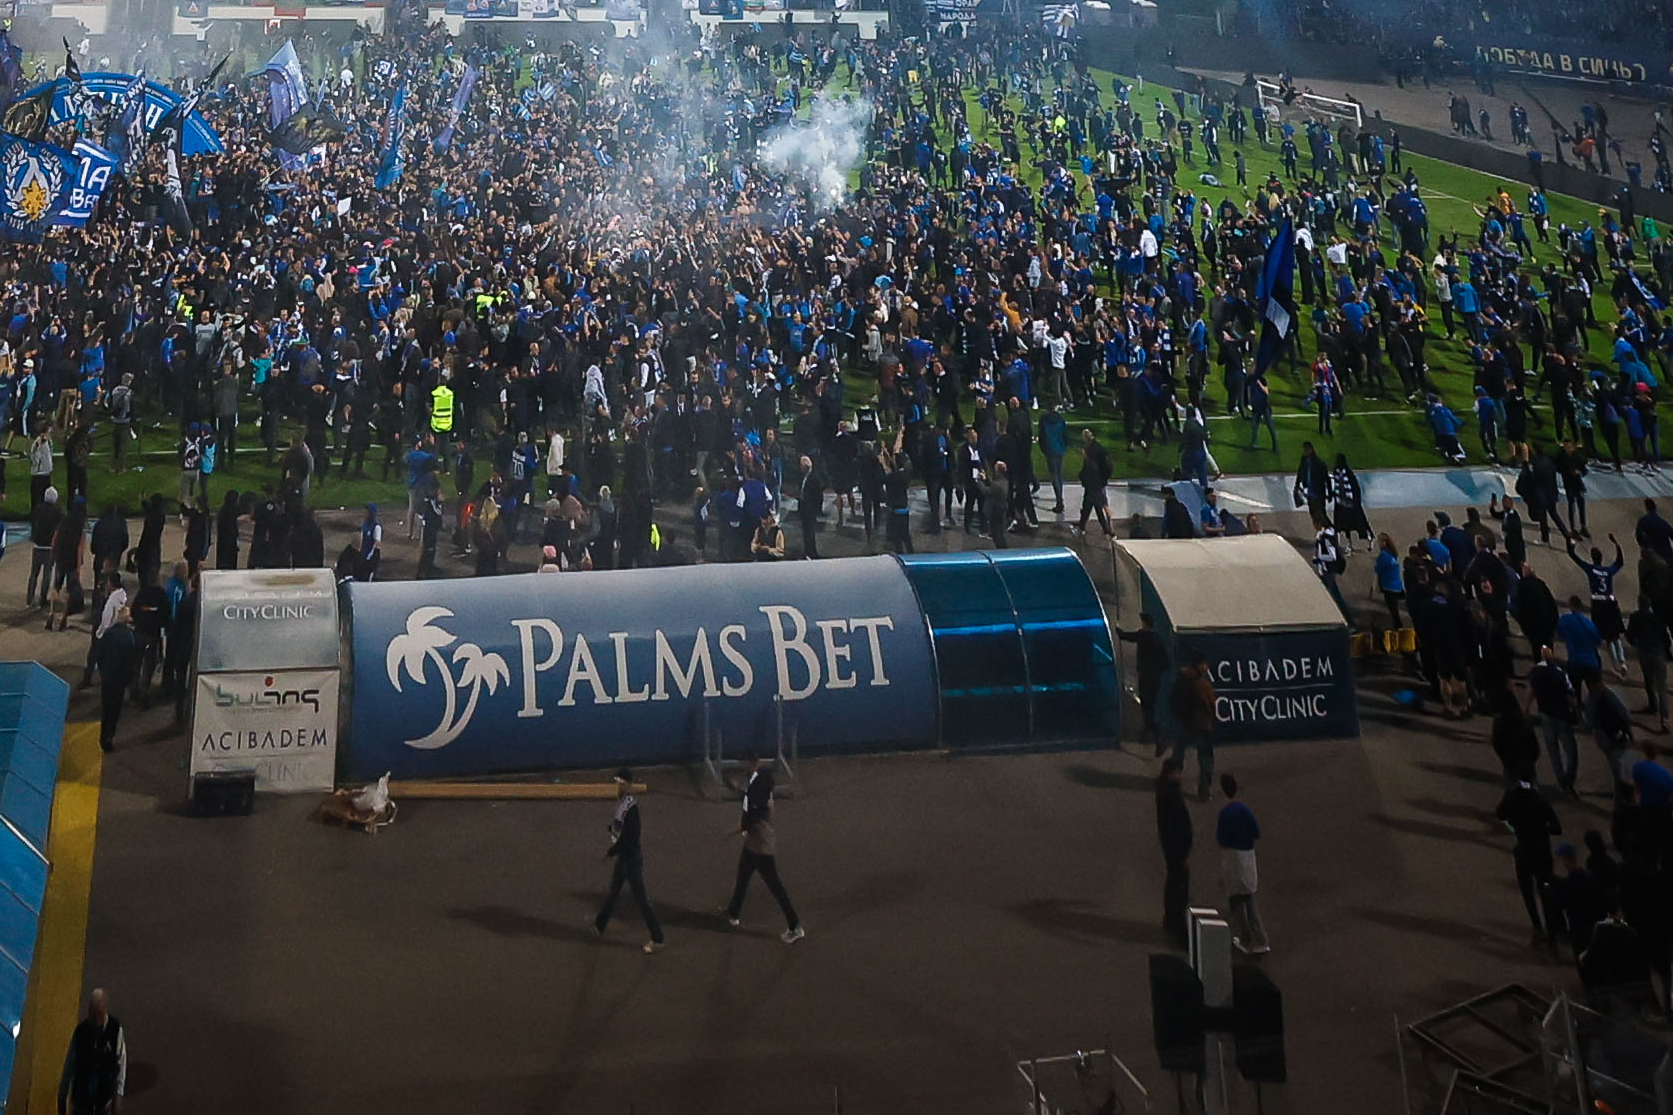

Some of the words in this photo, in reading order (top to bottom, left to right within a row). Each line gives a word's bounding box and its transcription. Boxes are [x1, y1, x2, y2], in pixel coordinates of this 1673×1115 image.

[223, 604, 313, 621] CITYCLINIC
[510, 618, 754, 718] PALMS
[758, 604, 894, 702] BET
[1215, 694, 1327, 722] CITYCLINIC
[202, 728, 328, 752] ACIBADEM
